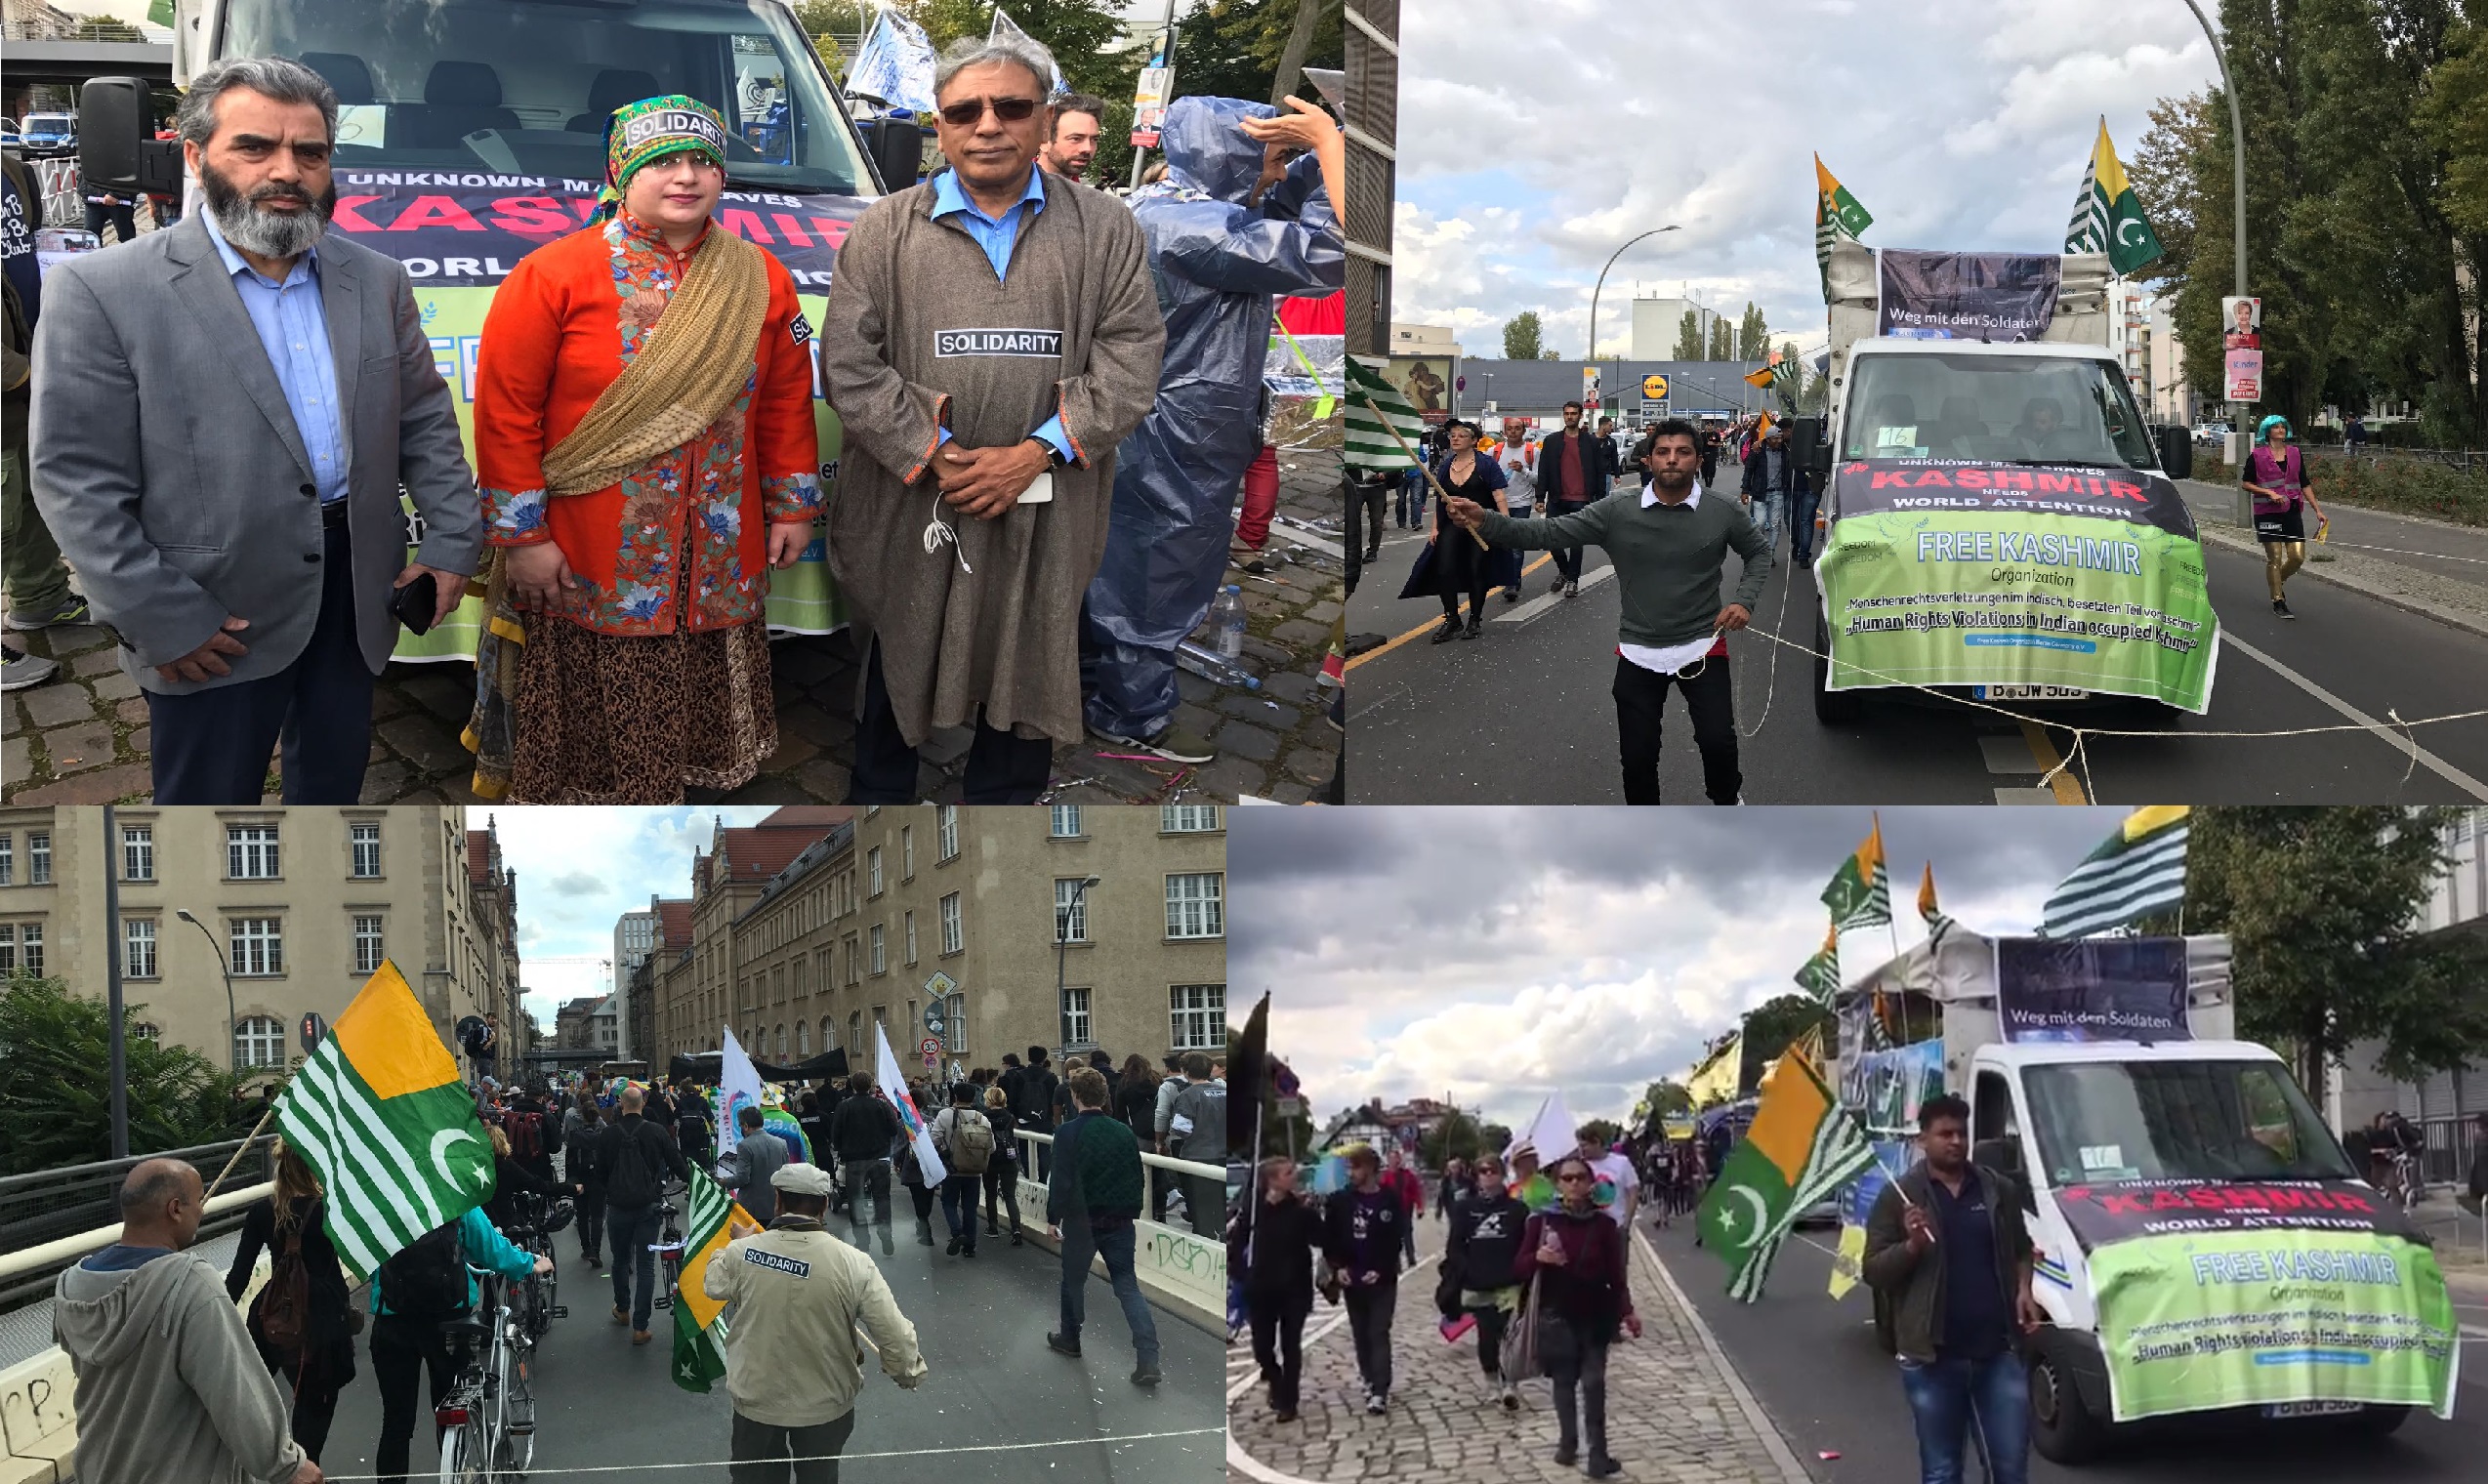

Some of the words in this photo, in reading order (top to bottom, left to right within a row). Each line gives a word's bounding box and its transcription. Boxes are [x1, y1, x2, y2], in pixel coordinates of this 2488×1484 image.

[631, 111, 726, 149] SOLIDARITY
[348, 173, 546, 187] UNKNOWN
[1888, 308, 1921, 325] Weg
[1925, 311, 1948, 325] mit
[1951, 311, 1978, 325] den
[941, 334, 1059, 352] SOLIDARITY
[1886, 428, 1907, 445] 16
[1871, 468, 2149, 503] KASHMIR
[1893, 497, 1980, 509] WORLD
[1992, 498, 2132, 518] ATTENTION
[1917, 531, 1994, 562] FREE
[1999, 531, 2142, 576] KASHMIR
[1991, 566, 2075, 587] Organization
[2067, 597, 2121, 614] besetzten
[2124, 604, 2142, 617] Teil
[1905, 610, 1950, 632] Rights
[1951, 610, 2025, 628] Violations
[2026, 611, 2037, 629] in
[2040, 612, 2087, 634] Indian
[2088, 622, 2153, 643] occupied
[2011, 1009, 2047, 1025] Weg
[2050, 1010, 2073, 1024] mit
[2077, 1010, 2106, 1025] den
[2110, 1010, 2172, 1028] Soldaten
[924, 1043, 936, 1051] 30
[2119, 1178, 2206, 1188] UNKNOWN
[2103, 1186, 2376, 1215] KASHMIR
[2143, 1218, 2231, 1233] WORLD
[2243, 1216, 2375, 1229] ATTENTION
[746, 1250, 807, 1275] SOLIDARITY
[2191, 1252, 2269, 1286] FREE
[2269, 1249, 2401, 1287] KASHMIR
[2194, 1332, 2241, 1356] Rights
